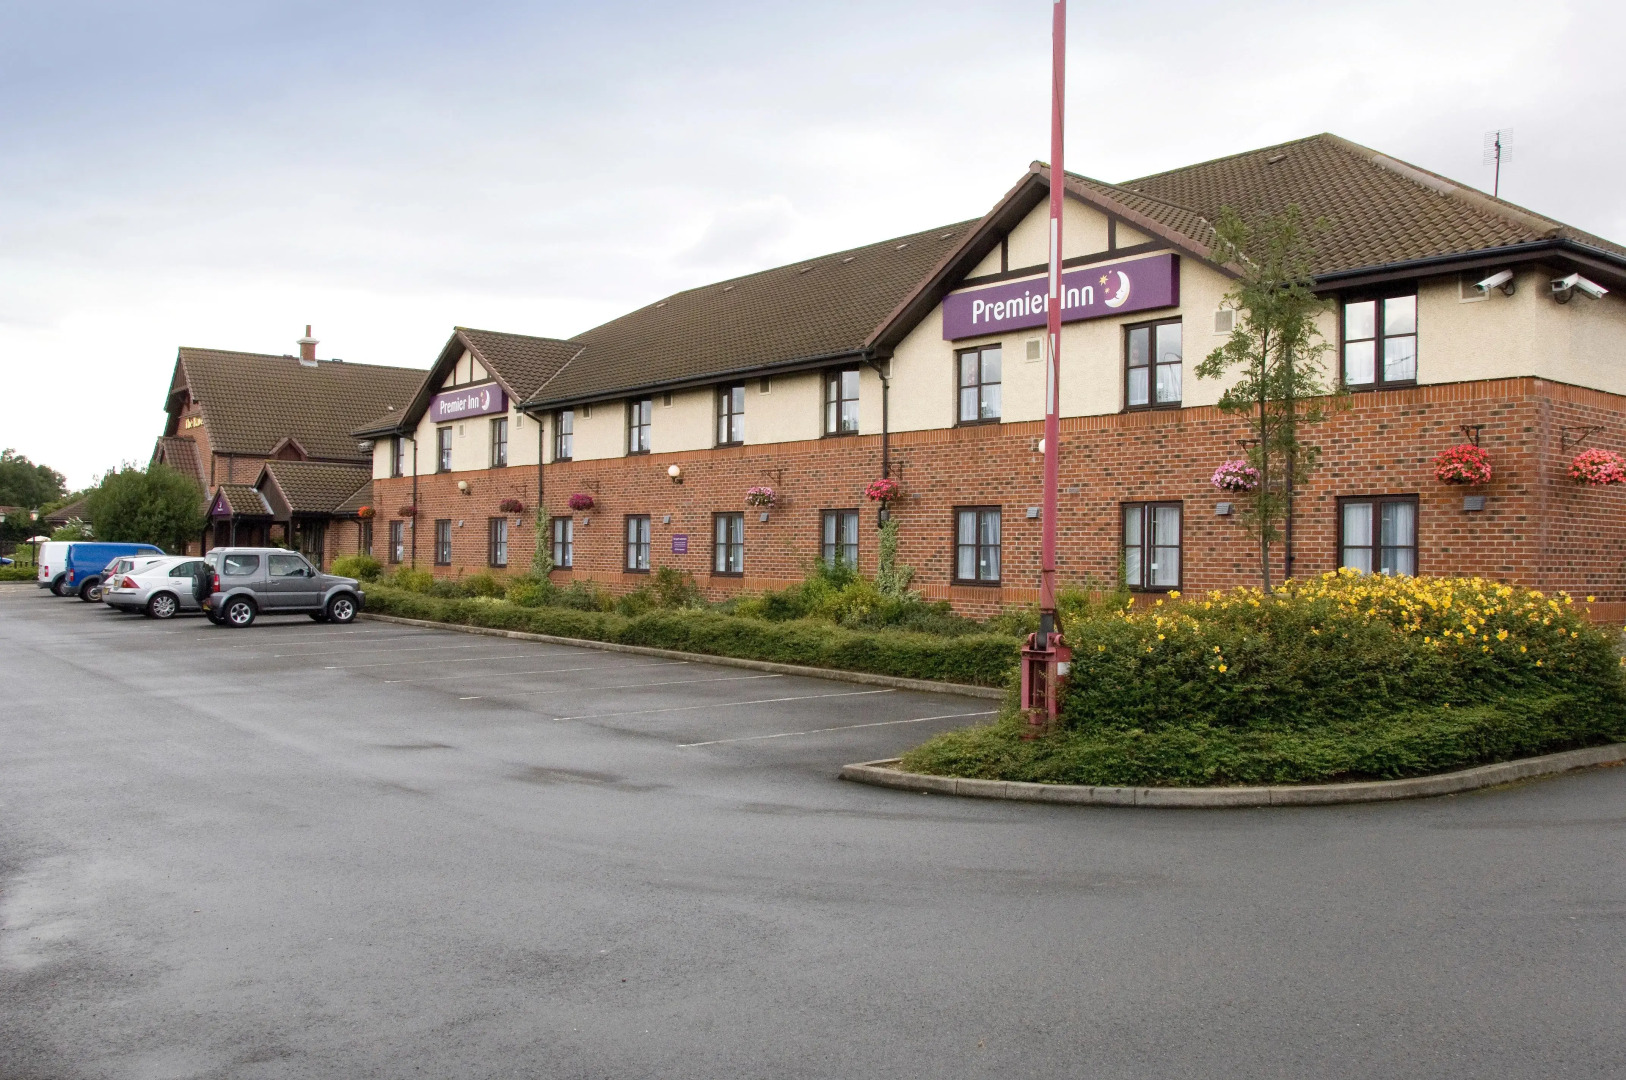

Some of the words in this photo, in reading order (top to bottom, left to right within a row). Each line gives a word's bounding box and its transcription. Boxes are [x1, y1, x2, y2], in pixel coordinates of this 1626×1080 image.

[1061, 284, 1094, 309] Inn
[440, 398, 467, 415] Premier
[469, 395, 479, 410] Inn
